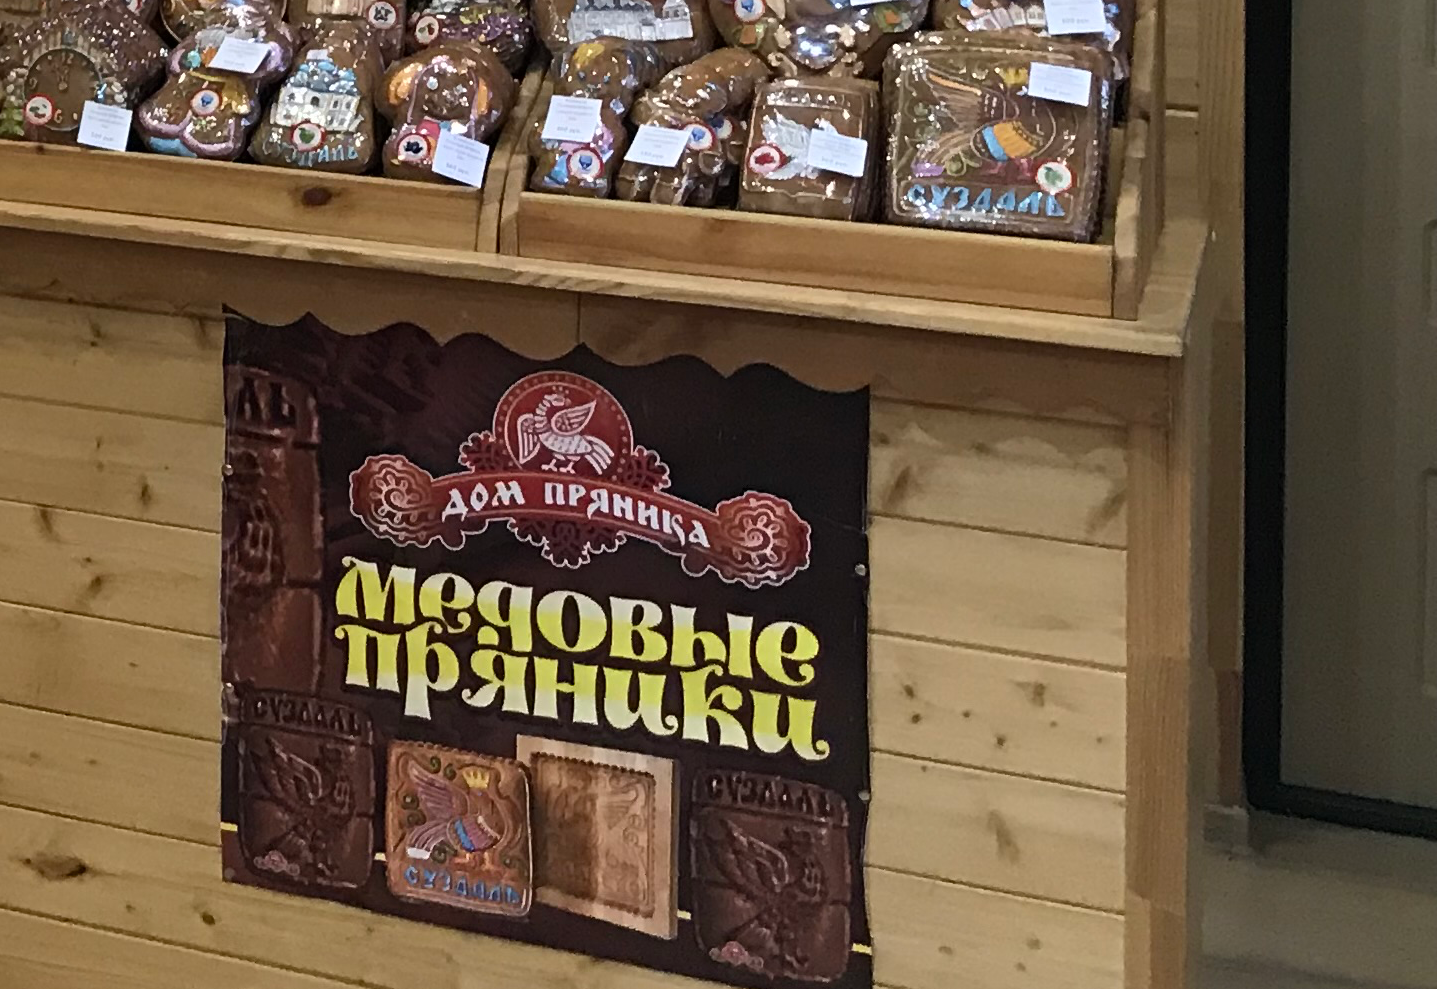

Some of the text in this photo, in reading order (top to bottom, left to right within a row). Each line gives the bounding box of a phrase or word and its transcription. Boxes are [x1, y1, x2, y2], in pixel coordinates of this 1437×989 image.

[907, 184, 1066, 218] СУЗДАЛЬ
[442, 481, 711, 548] ДОМ ПРЯНИКА
[705, 773, 832, 819] СУЗДАЛЬ
[403, 865, 521, 904] СУЗДАЛЬ
